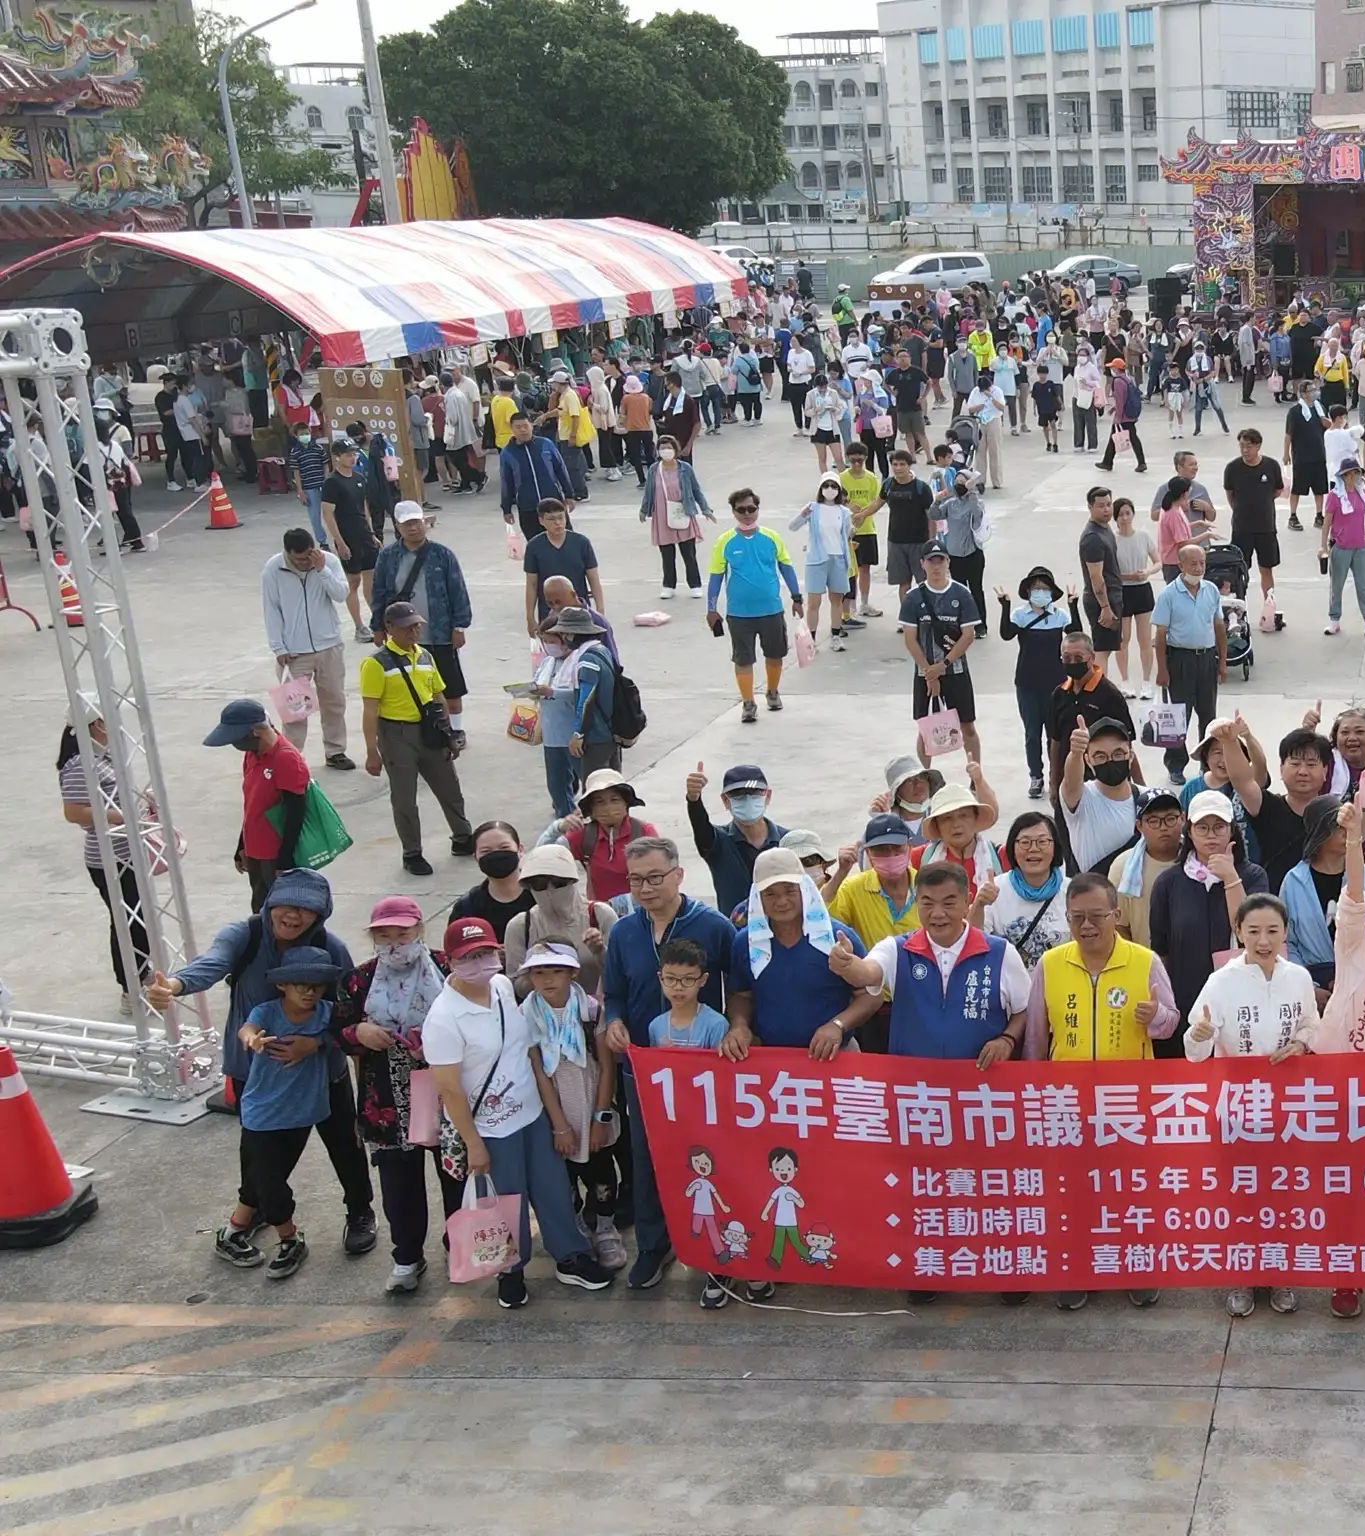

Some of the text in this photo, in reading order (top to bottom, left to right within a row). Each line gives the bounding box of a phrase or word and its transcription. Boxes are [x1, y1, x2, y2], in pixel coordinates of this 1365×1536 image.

[486, 1101, 524, 1128] Snoopy
[1090, 1204, 1156, 1234] 上午
[1164, 1206, 1326, 1230] 6:00~9:30
